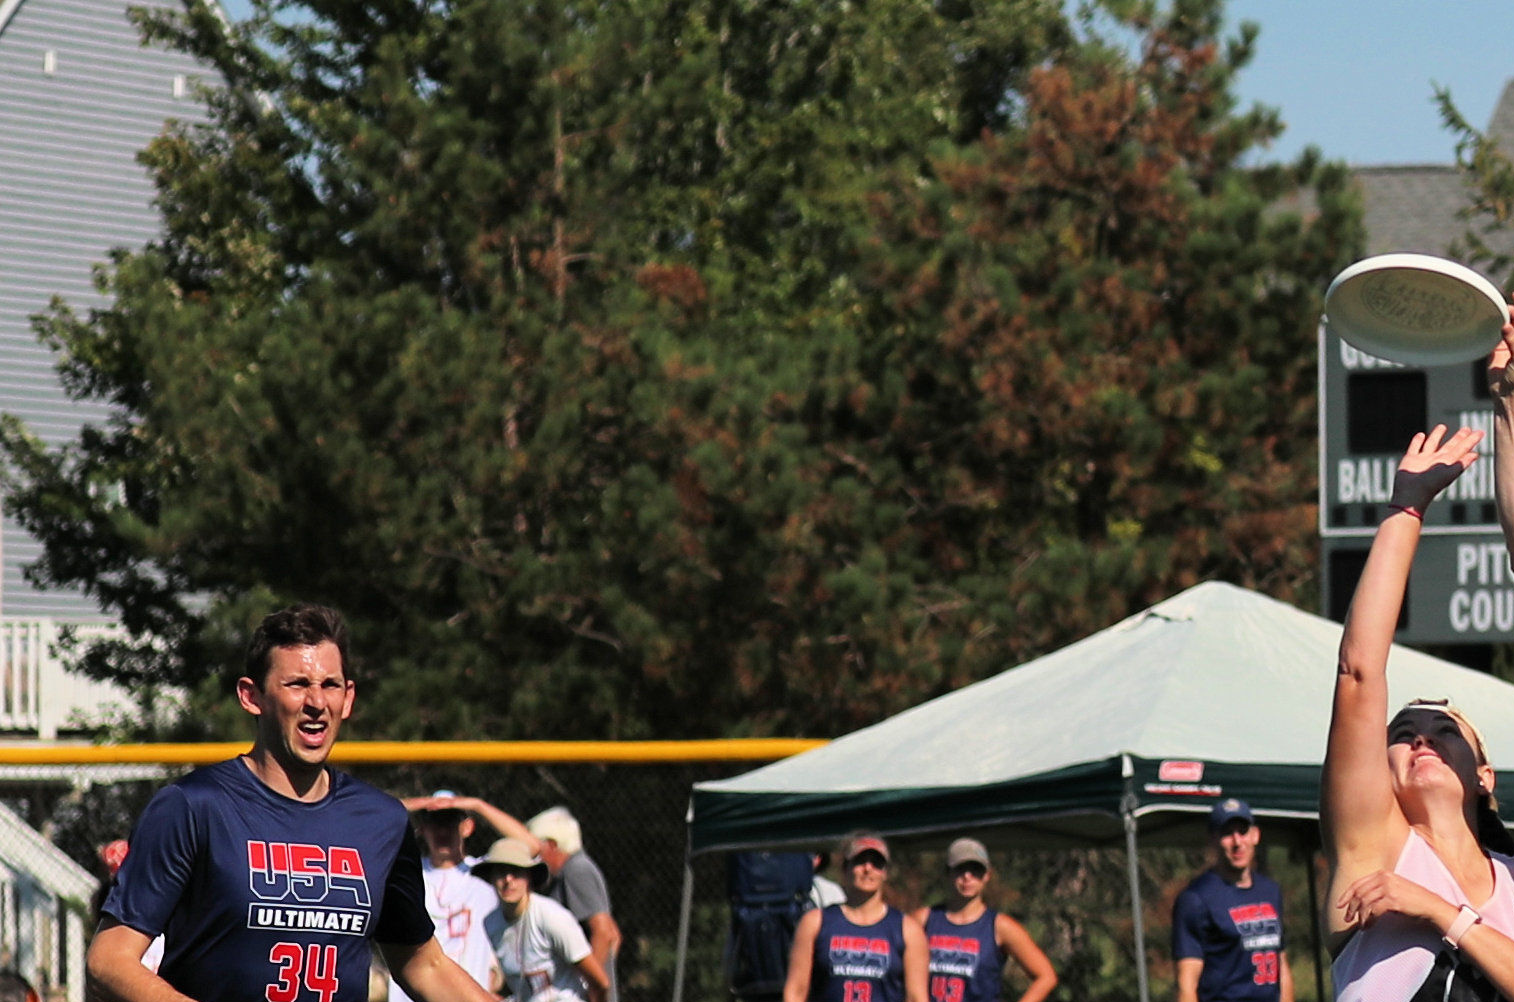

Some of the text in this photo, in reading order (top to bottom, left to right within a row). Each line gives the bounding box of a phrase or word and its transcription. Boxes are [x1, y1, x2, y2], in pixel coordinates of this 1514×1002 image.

[247, 839, 372, 907] USA
[257, 908, 366, 932] ULTIMATE
[829, 935, 890, 972] USA
[1251, 950, 1279, 986] 33
